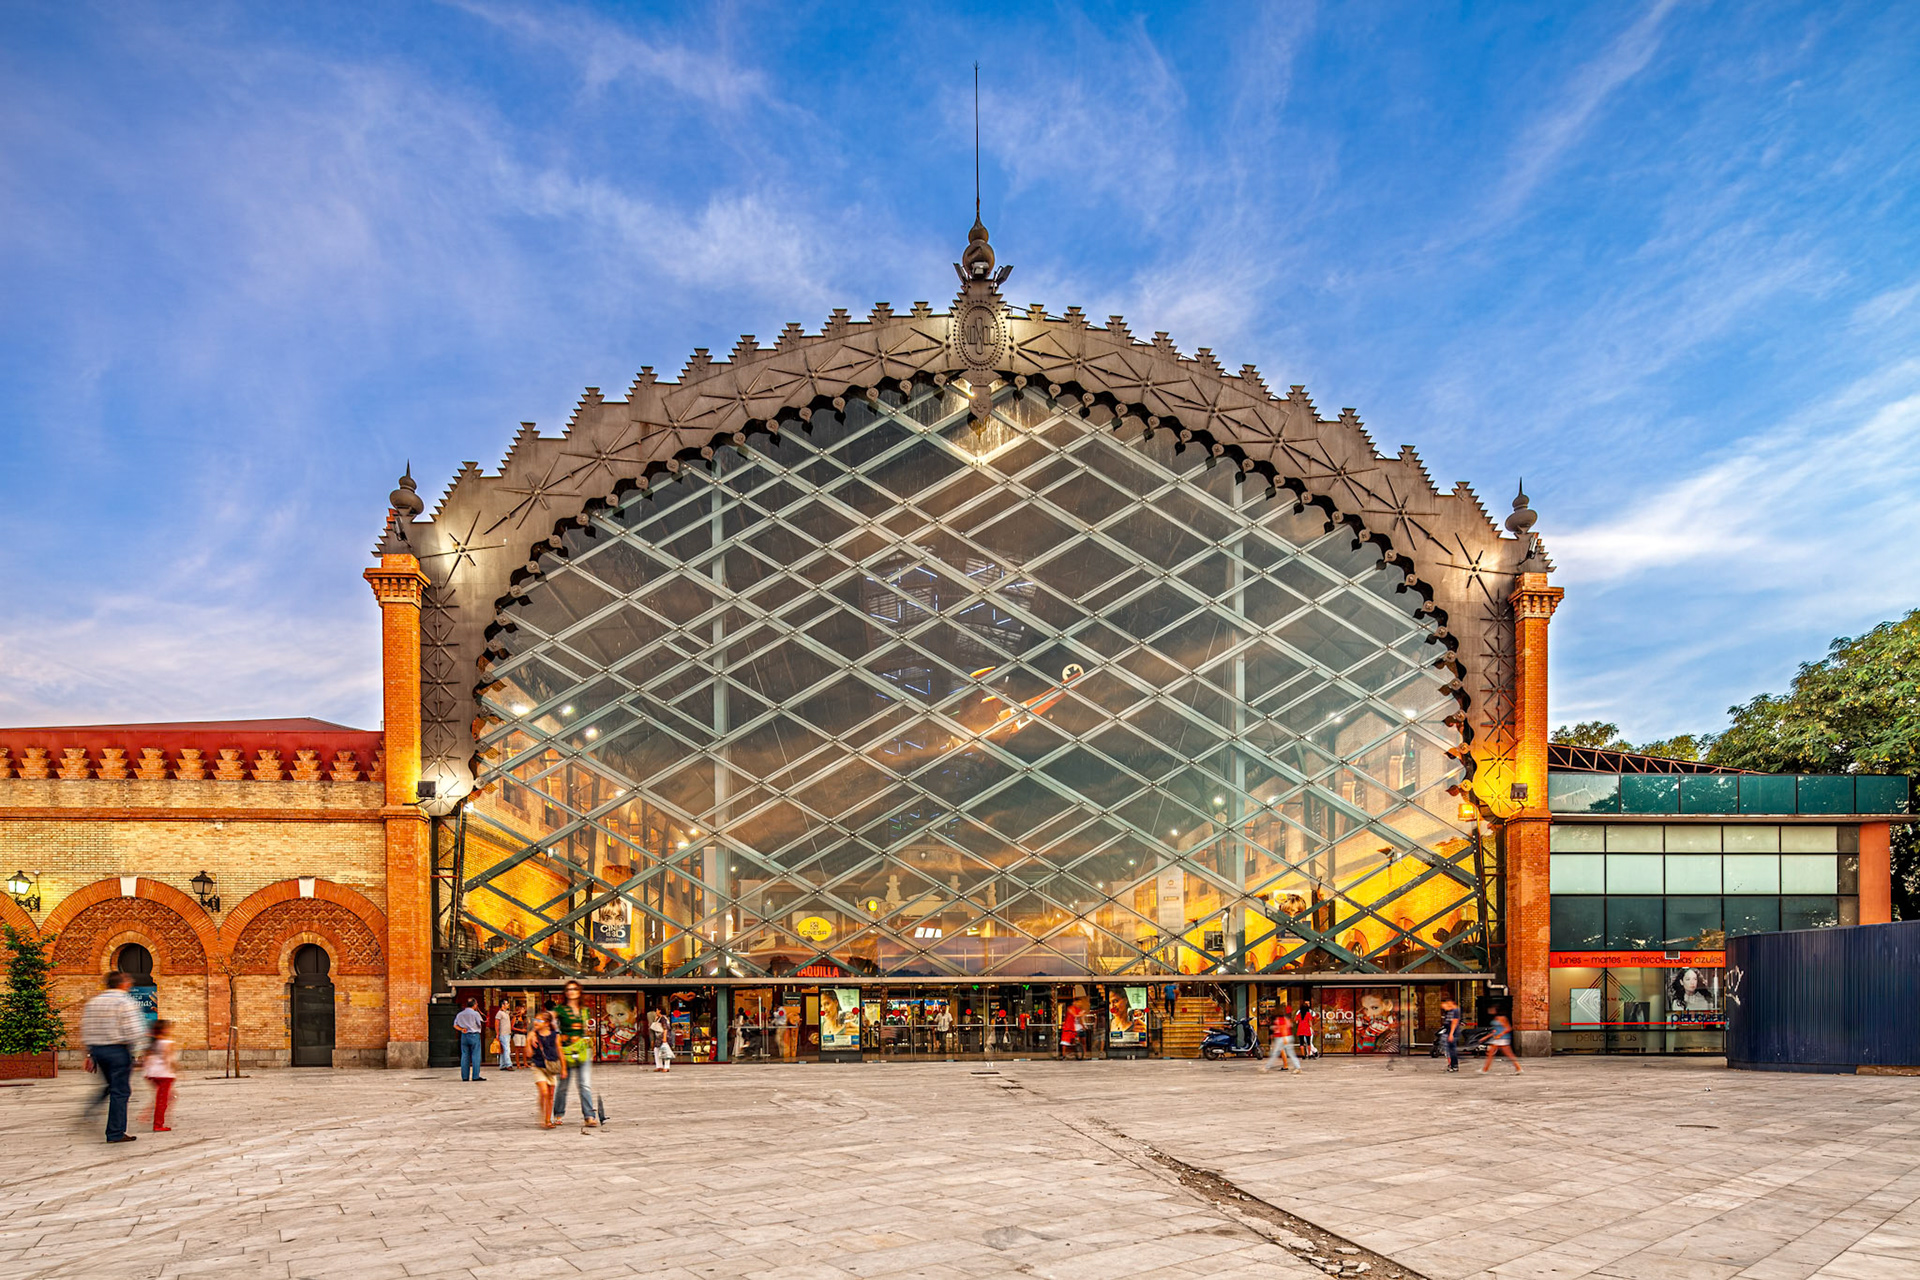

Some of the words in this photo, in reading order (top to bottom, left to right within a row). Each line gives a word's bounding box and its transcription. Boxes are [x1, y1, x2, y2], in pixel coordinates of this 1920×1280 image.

[1558, 956, 1581, 964] lunes
[1591, 956, 1621, 964] martes
[1694, 954, 1723, 964] azules
